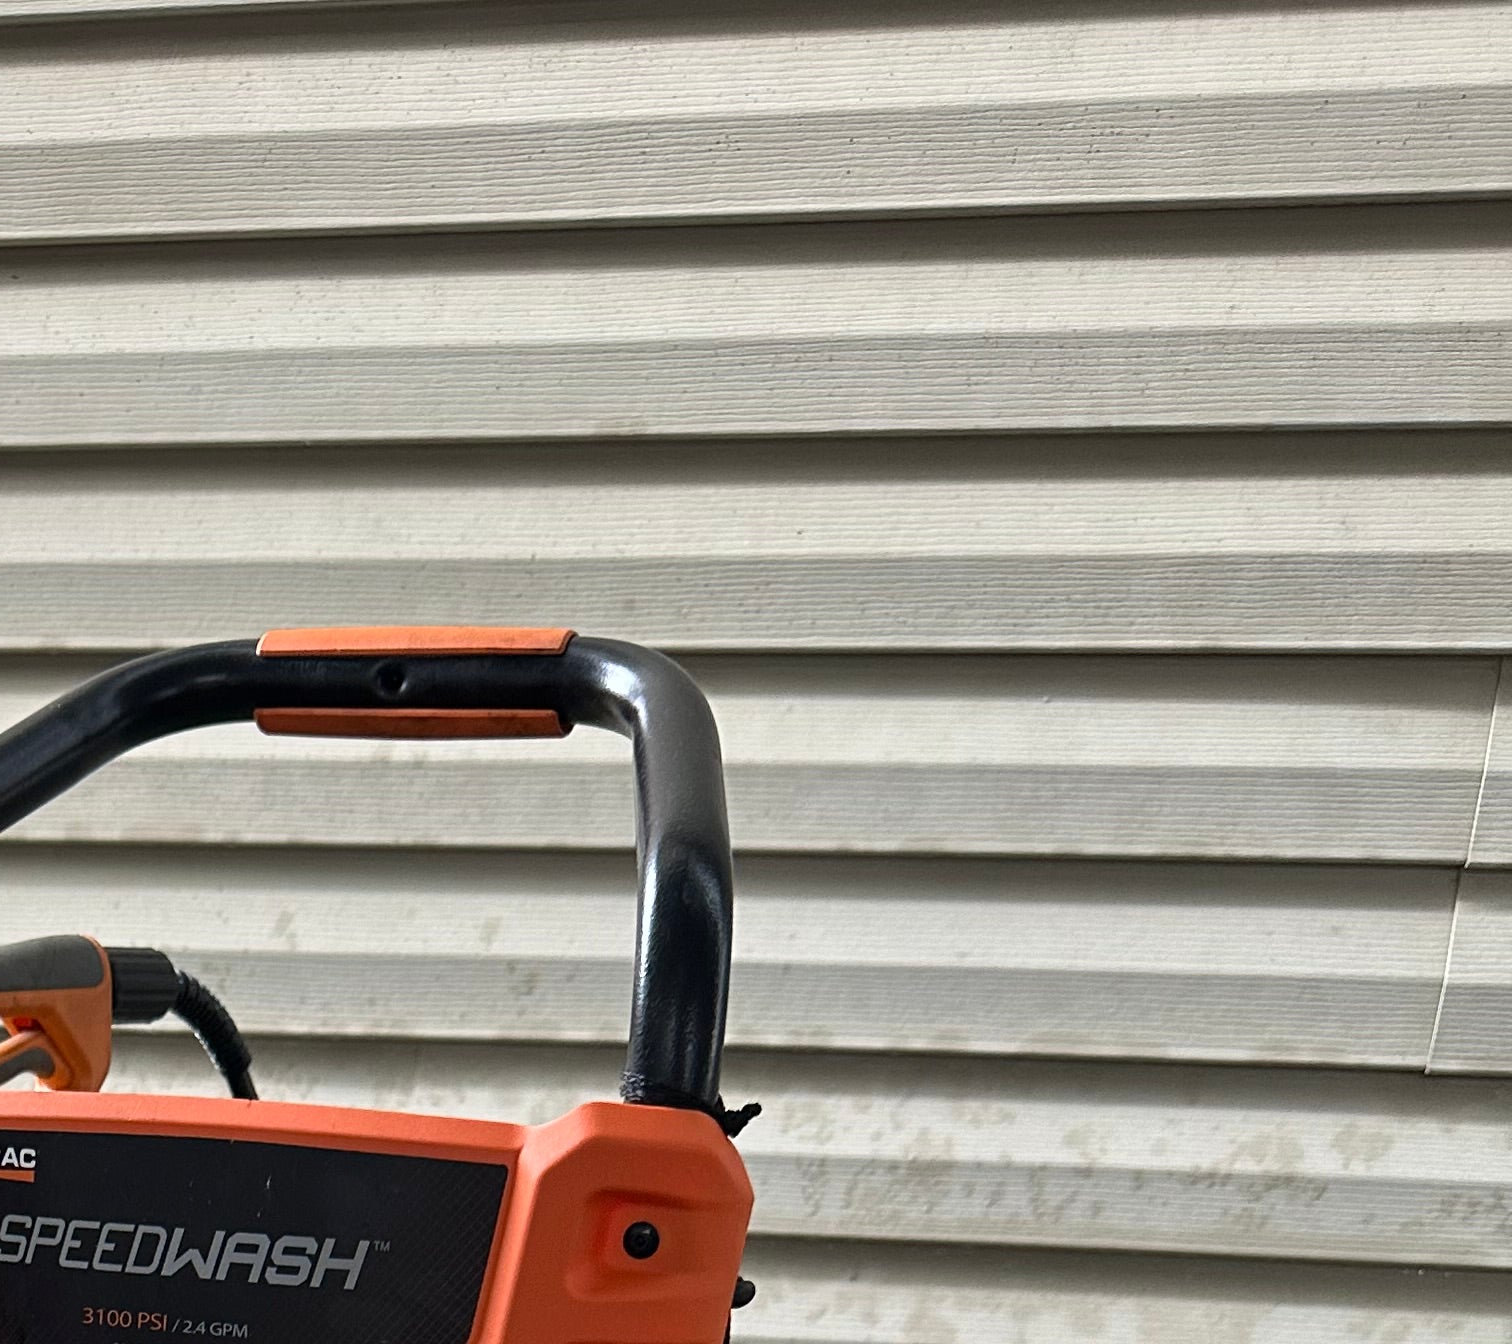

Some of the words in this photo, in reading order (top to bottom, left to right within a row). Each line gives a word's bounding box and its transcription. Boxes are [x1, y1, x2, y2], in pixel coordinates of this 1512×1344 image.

[82, 1307, 132, 1328] 3100
[137, 1311, 168, 1332] PSI
[182, 1320, 206, 1335] 2.4
[209, 1321, 249, 1338] GPM
